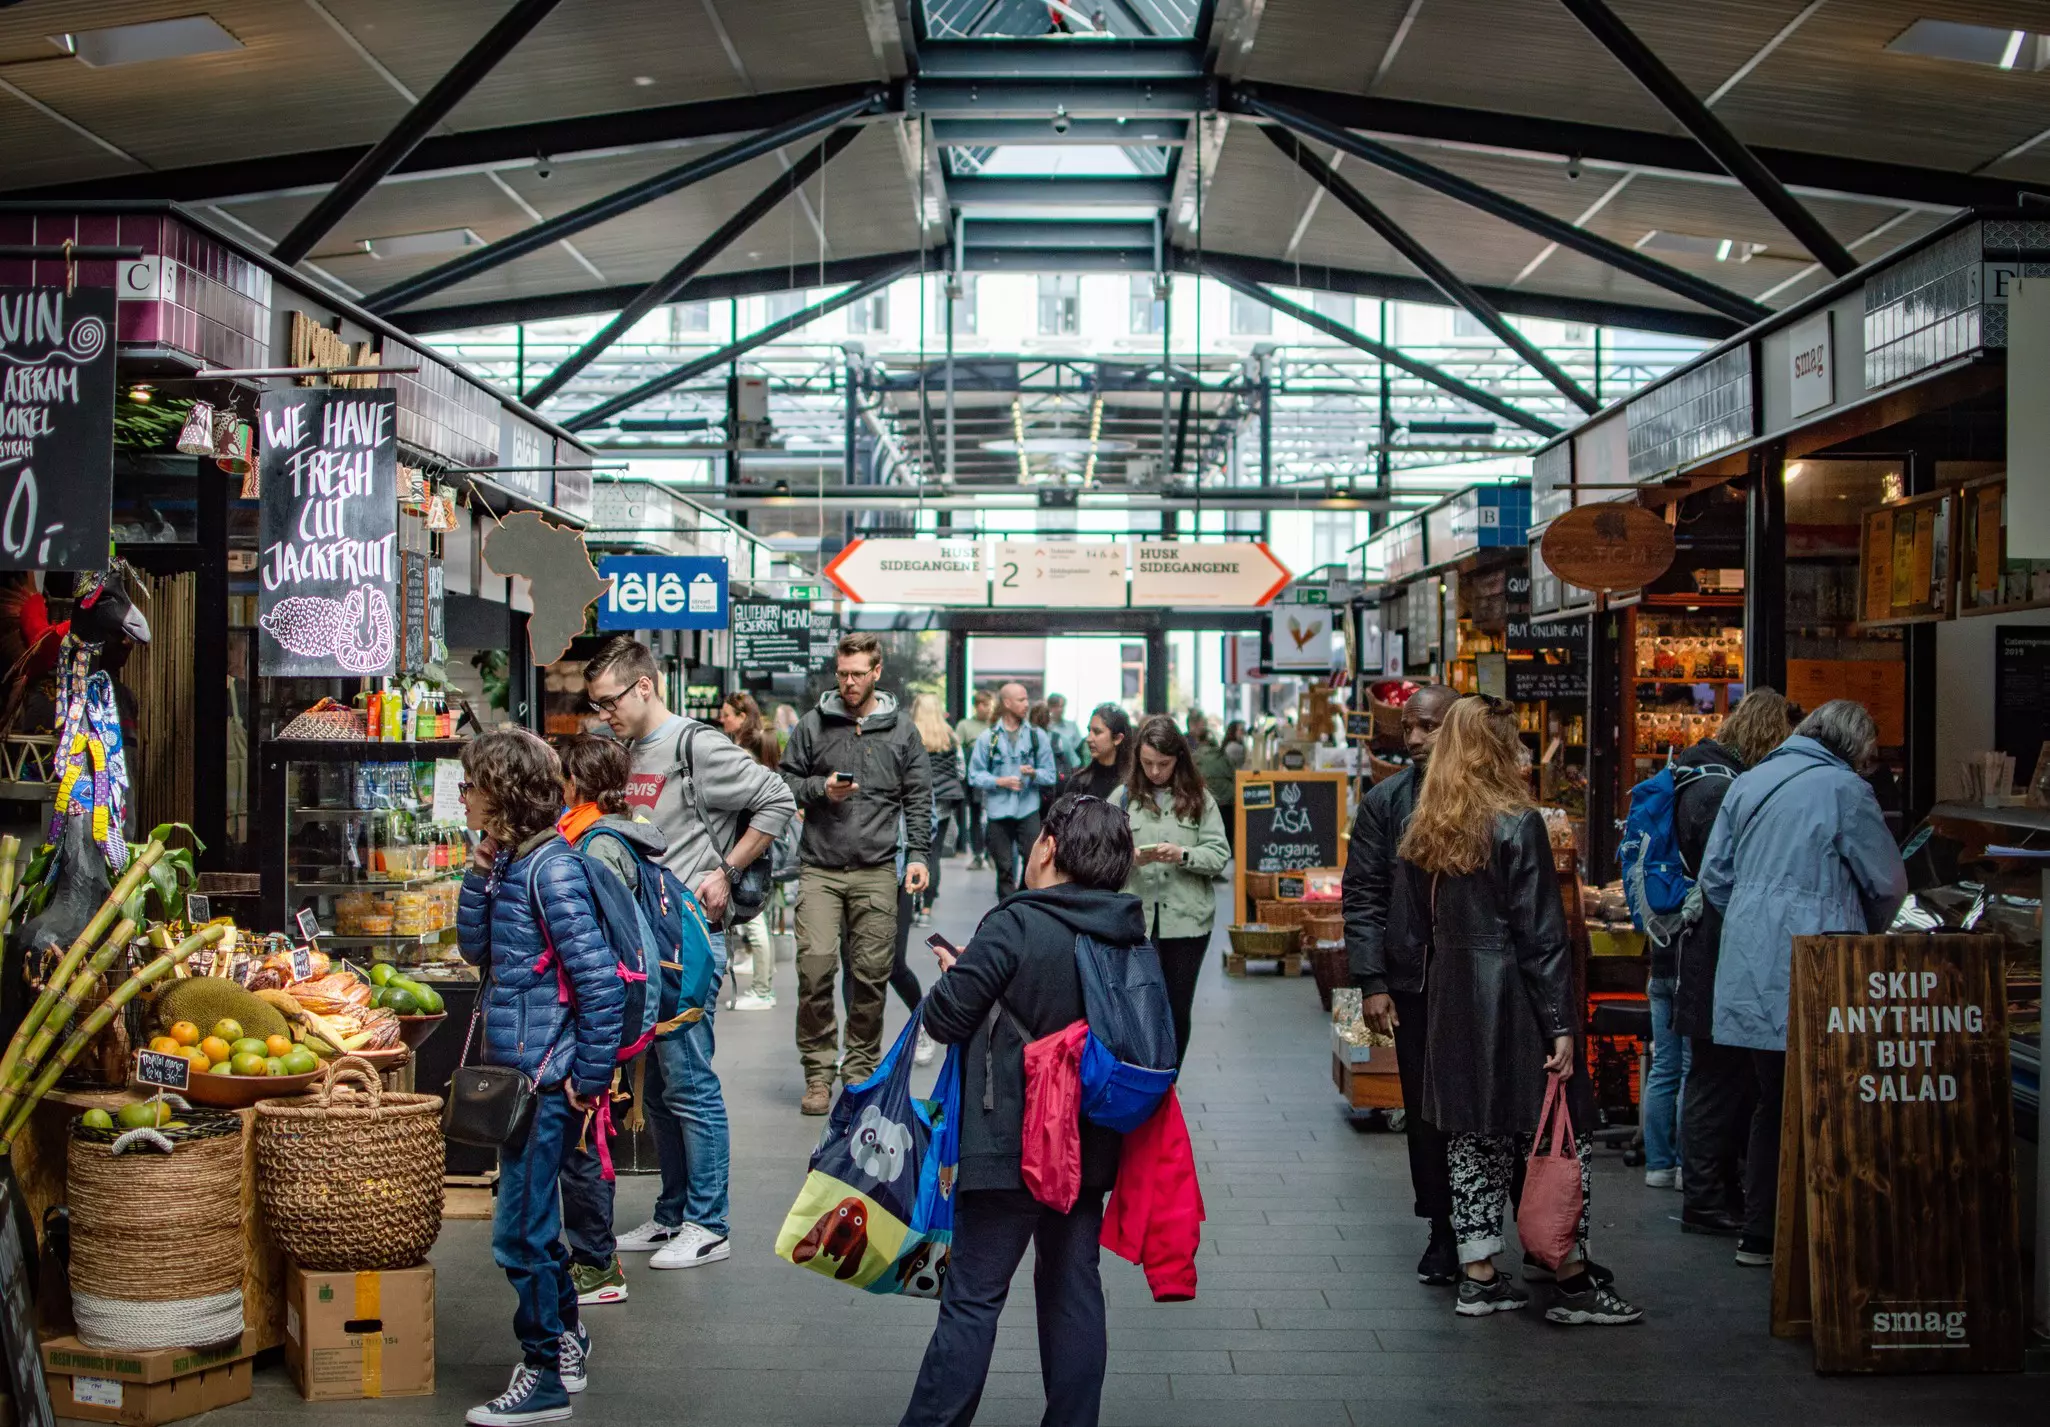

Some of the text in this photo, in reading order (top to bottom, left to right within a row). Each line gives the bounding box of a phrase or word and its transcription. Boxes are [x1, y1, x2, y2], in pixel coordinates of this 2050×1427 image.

[127, 263, 150, 290] C
[0, 291, 64, 348] VIN
[1795, 344, 1824, 378] smag
[264, 401, 395, 449] WE HAVE
[284, 445, 374, 498] FRESH
[298, 497, 352, 544] CUT
[628, 504, 641, 518] C
[1484, 510, 1496, 523] B
[262, 532, 397, 592] JACKFRUIT
[880, 560, 980, 571] SIDEGANGENE
[940, 547, 980, 558] HUSK
[1139, 548, 1179, 559] HUSK
[1002, 562, 1020, 587] 2
[1139, 562, 1240, 573] SIDEGANGENE
[608, 572, 686, 613] lêlê
[734, 604, 781, 621] GLUTENFRI
[781, 609, 812, 629] MENU
[1507, 623, 1586, 638] BUY ONLINE AT
[1868, 971, 1938, 999] SKIP
[1827, 1005, 1984, 1034] ANYTHING
[1877, 1040, 1936, 1068] BUT
[1859, 1074, 1957, 1102] SALAD
[1873, 1307, 1967, 1339] smag
[384, 1337, 398, 1345] 154
[50, 1350, 142, 1374] FRESH PRODUCE OF UGANDA
